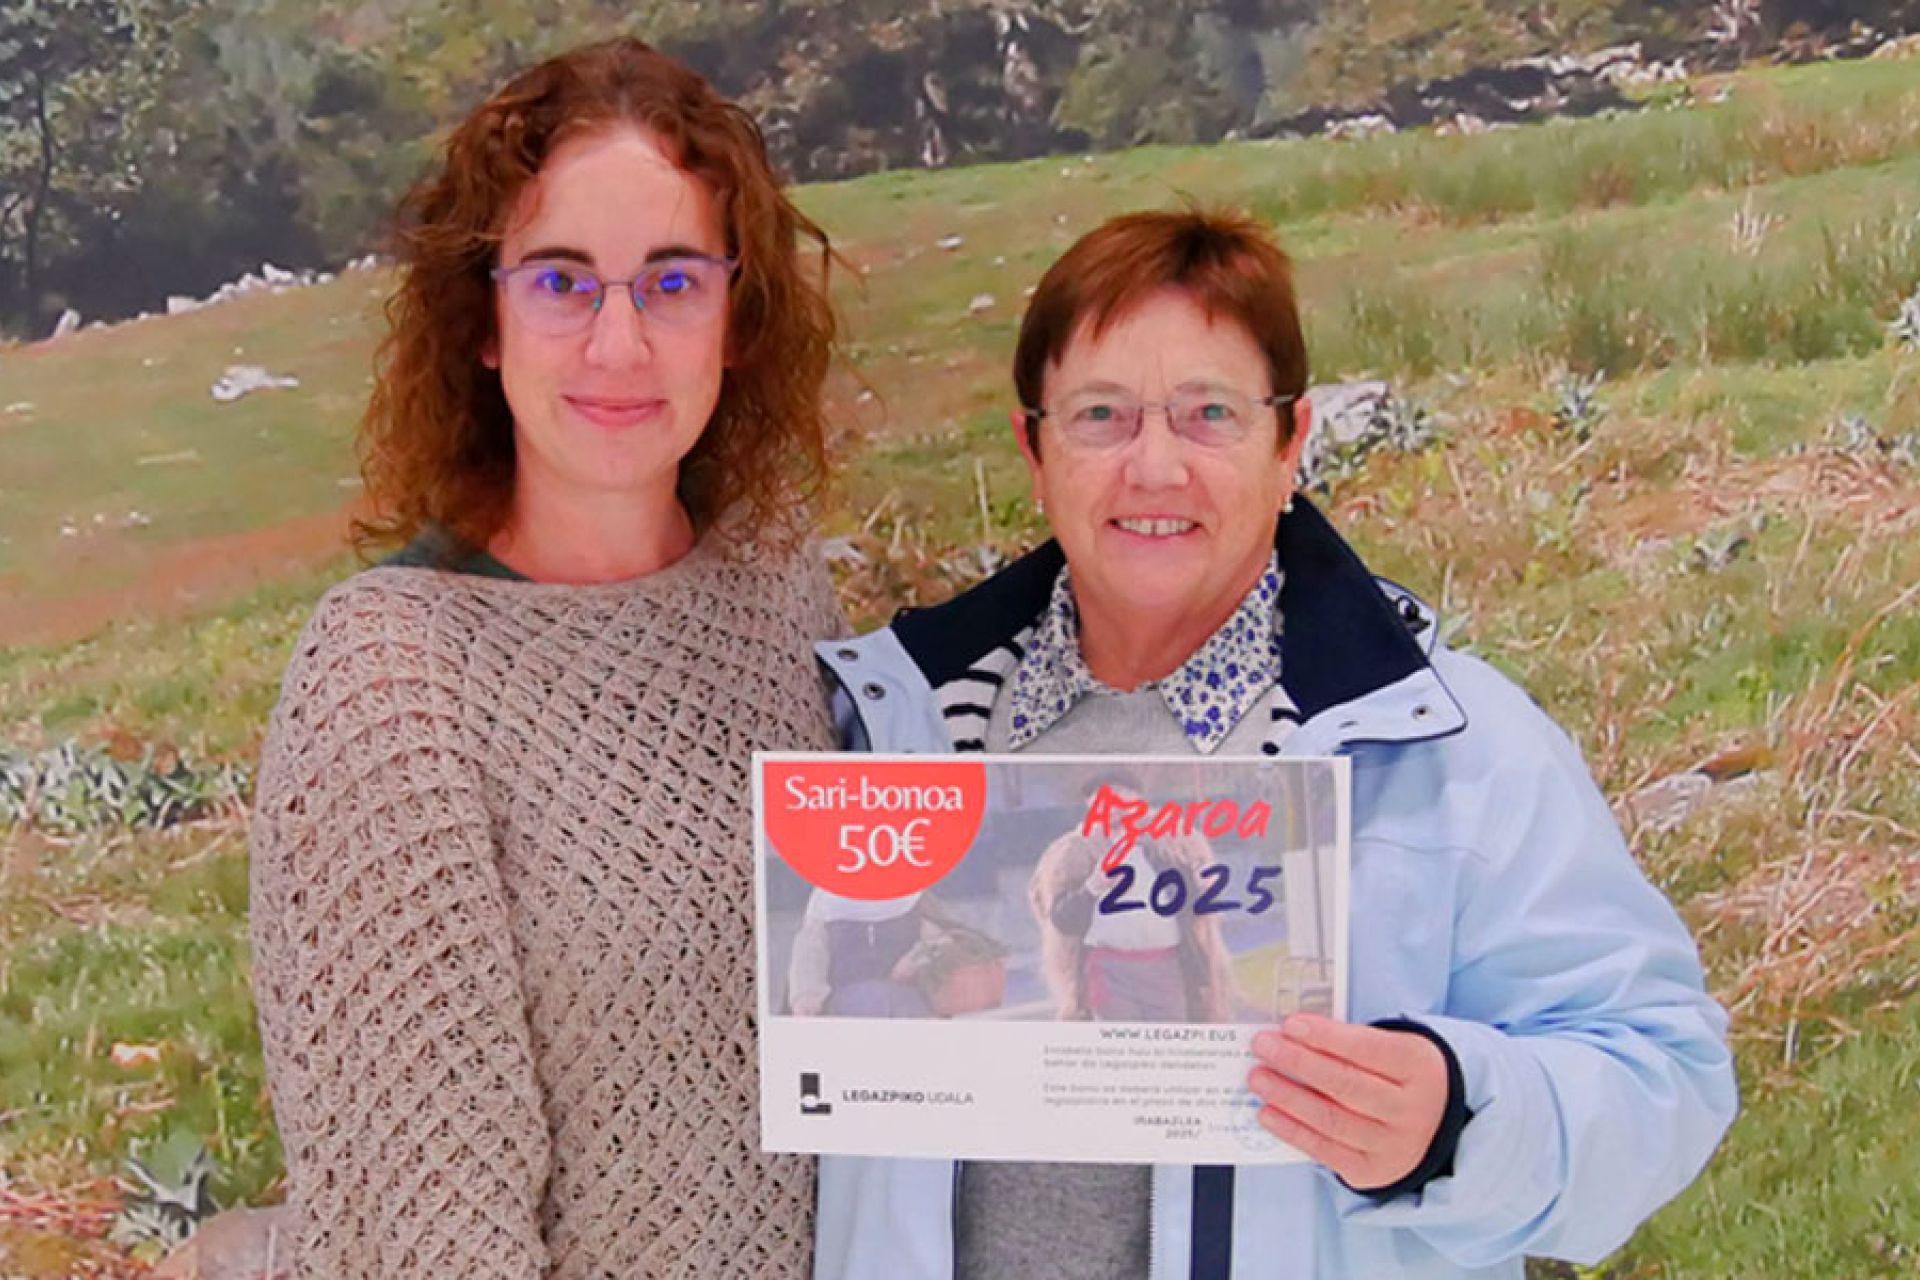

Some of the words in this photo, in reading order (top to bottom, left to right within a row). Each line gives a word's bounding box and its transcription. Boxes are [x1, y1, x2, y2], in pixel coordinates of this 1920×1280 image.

[785, 775, 965, 811] Sari-bonoa
[836, 817, 933, 874] 50€
[1082, 783, 1273, 873] Azaroa
[1098, 863, 1284, 918] 2025
[1100, 1028, 1237, 1042] WWW.LEGAZPI.EUS
[842, 1089, 925, 1103] LEGAZPIKO
[927, 1091, 975, 1104] UDALA
